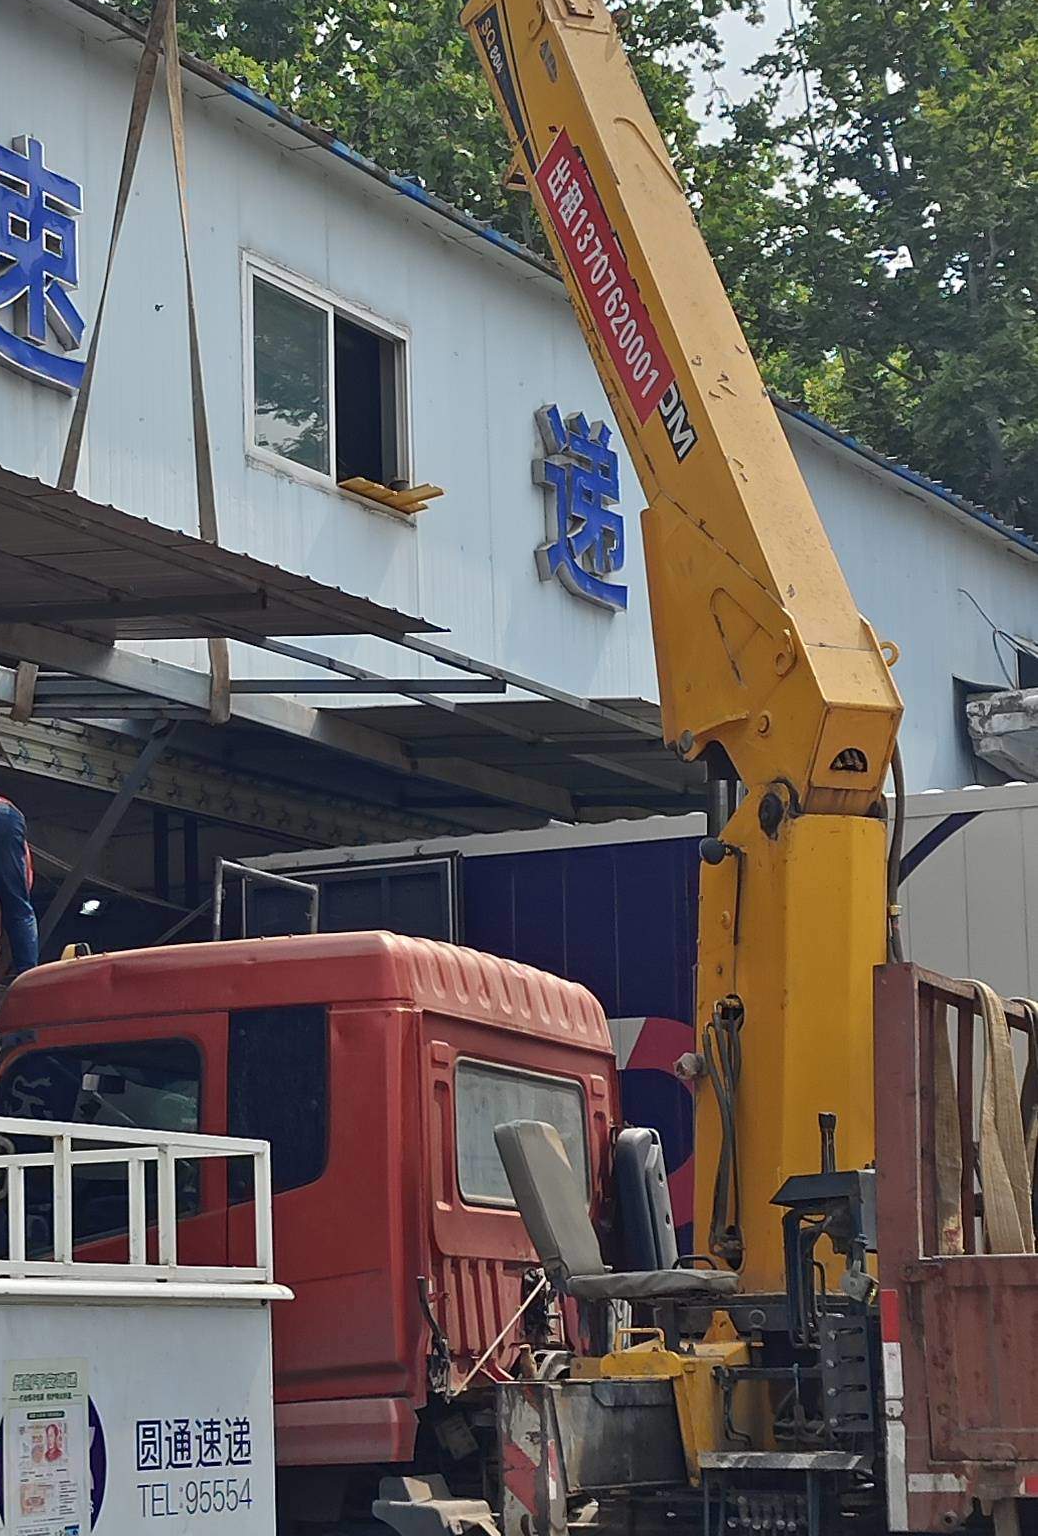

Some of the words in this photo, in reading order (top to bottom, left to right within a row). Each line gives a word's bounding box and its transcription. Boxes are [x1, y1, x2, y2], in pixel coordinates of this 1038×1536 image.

[532, 404, 628, 613] 递
[136, 1416, 252, 1471] 圆通速递
[136, 1477, 253, 1518] TEL:95554
